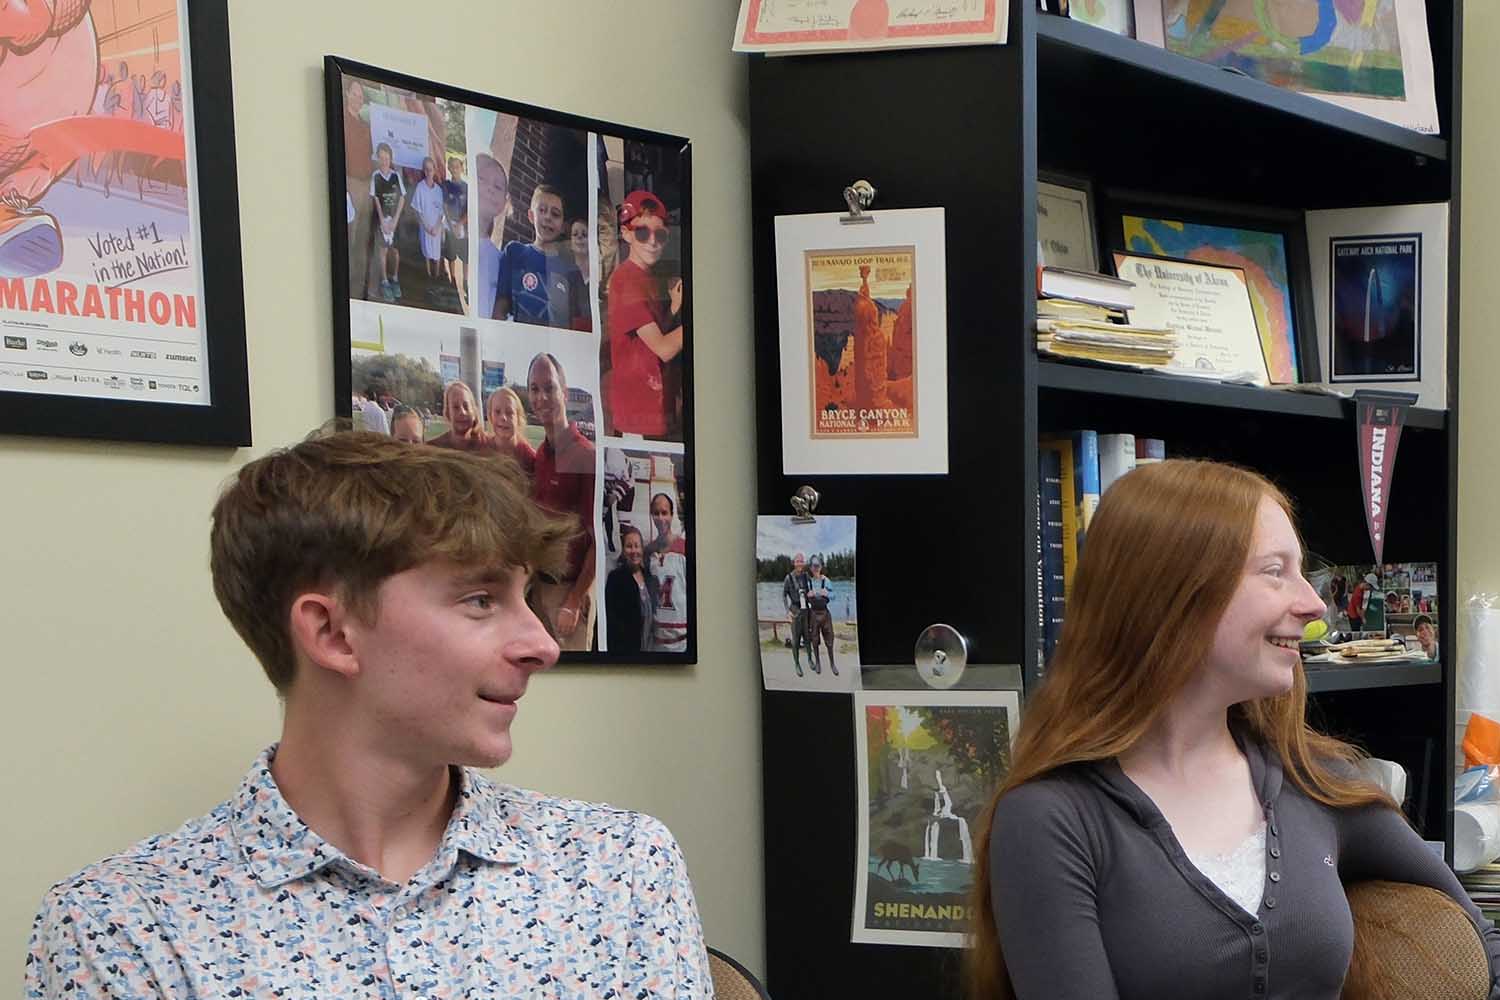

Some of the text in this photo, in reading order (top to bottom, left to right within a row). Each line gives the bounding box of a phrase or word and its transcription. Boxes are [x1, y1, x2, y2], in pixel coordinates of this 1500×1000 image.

[88, 221, 164, 258] Voted #1
[92, 234, 189, 283] in the Nation!
[1361, 246, 1374, 255] ARCH
[1375, 245, 1398, 255] NATIONAL
[1399, 244, 1413, 254] PARK
[824, 258, 853, 266] NAVAJO
[854, 257, 872, 265] LOOP
[876, 256, 895, 264] TRAIL
[1155, 266, 1195, 285] University
[0, 277, 197, 329] MARATHON
[819, 419, 910, 428] NATIONAL PARK
[822, 408, 907, 420] BRYCE CANYON
[1371, 427, 1387, 517] INDIANA
